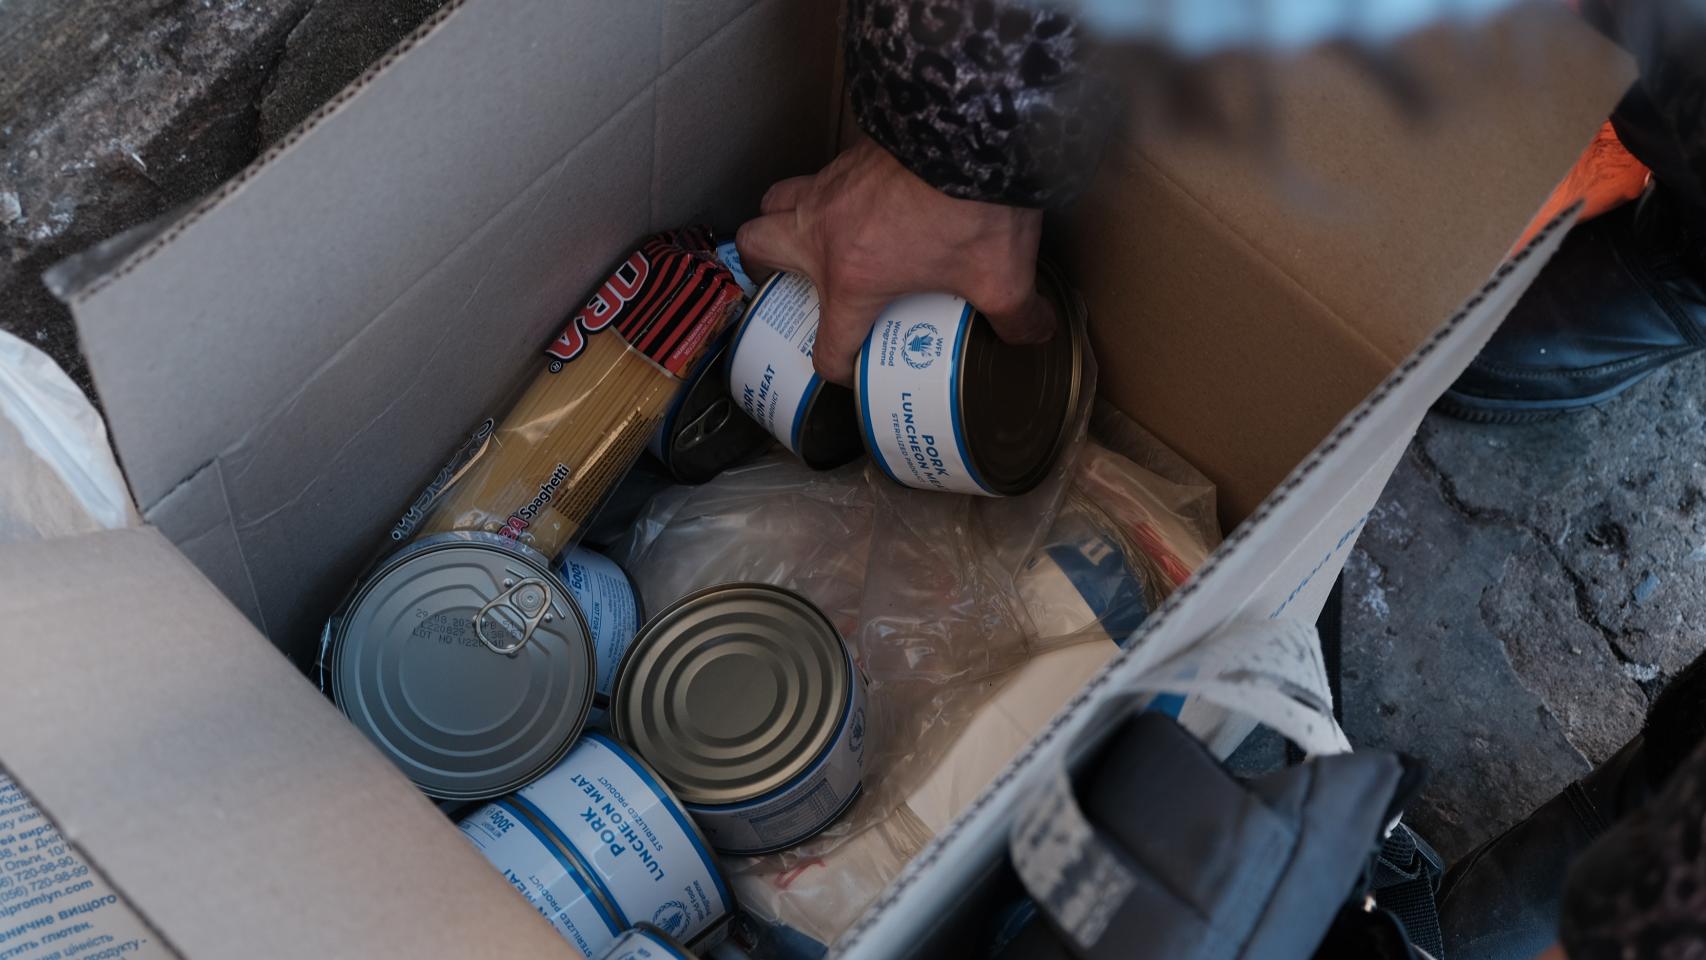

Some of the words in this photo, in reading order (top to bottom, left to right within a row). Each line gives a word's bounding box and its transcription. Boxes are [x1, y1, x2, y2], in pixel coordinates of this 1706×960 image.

[880, 319, 894, 367] Programme
[893, 319, 901, 347] World
[934, 337, 944, 358] WFP
[888, 346, 898, 367] Food
[758, 364, 776, 401] MEAT
[901, 392, 930, 470] LUNCHEON
[921, 434, 950, 477] PORK
[520, 463, 570, 520] Spaghetti
[571, 561, 583, 591] 300g
[570, 773, 605, 804] MEAT
[598, 776, 628, 809] PRODUCT
[490, 809, 515, 833] 300g
[580, 805, 627, 858] PORK
[627, 807, 663, 852] STERILIZED
[601, 803, 666, 882] LUNCHEON
[28, 865, 89, 892] 720-98-99
[528, 875, 561, 912] PRODUCT
[58, 894, 118, 920] вищого
[41, 921, 94, 944] глютен.
[560, 912, 593, 959] STERILIZED
